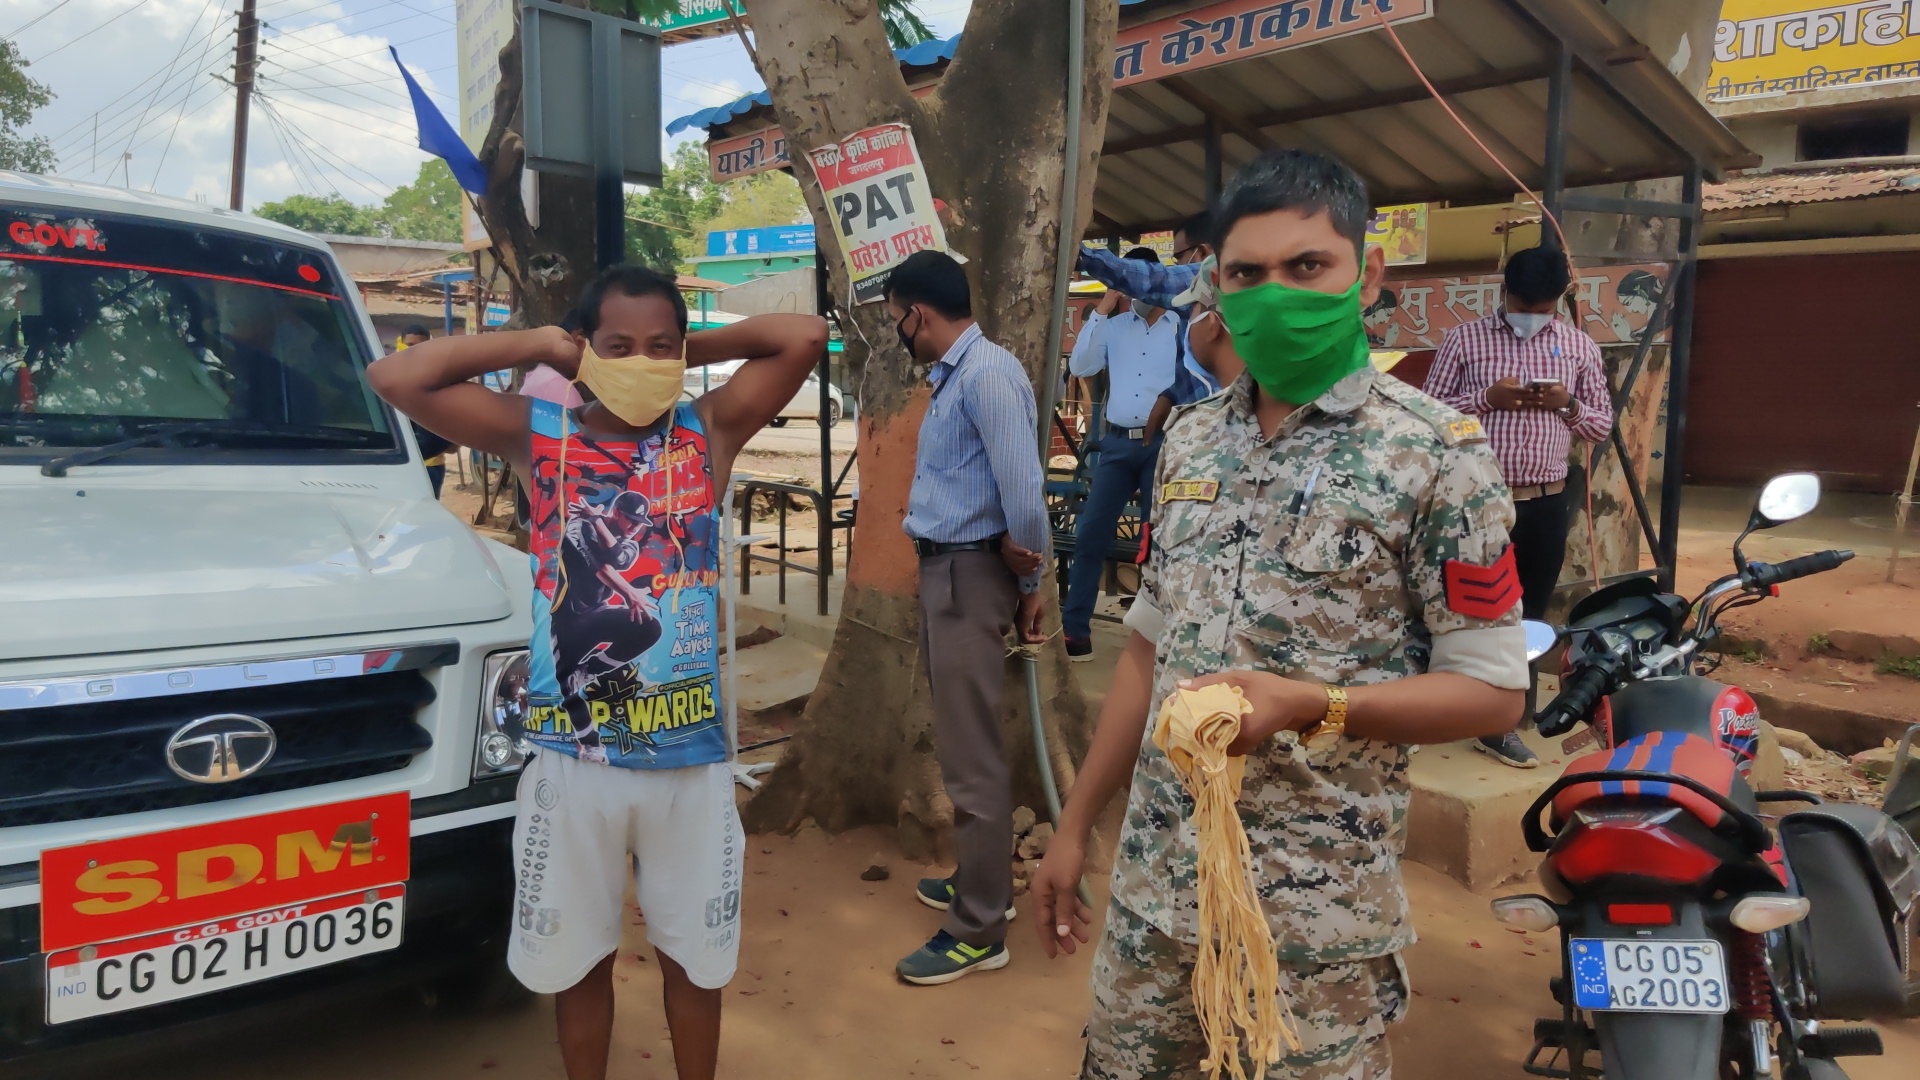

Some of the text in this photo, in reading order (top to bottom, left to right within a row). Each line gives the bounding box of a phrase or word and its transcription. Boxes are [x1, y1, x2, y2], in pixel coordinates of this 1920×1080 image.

[832, 172, 916, 237] PAT
[9, 221, 106, 252] GOVT.
[670, 636, 712, 660] Aayega
[173, 905, 308, 943] C.G. GOVT
[96, 901, 395, 1001] CG 02 H 0036
[1614, 944, 1704, 975] CG 05
[57, 981, 88, 998] IND
[1582, 984, 1606, 994] IND
